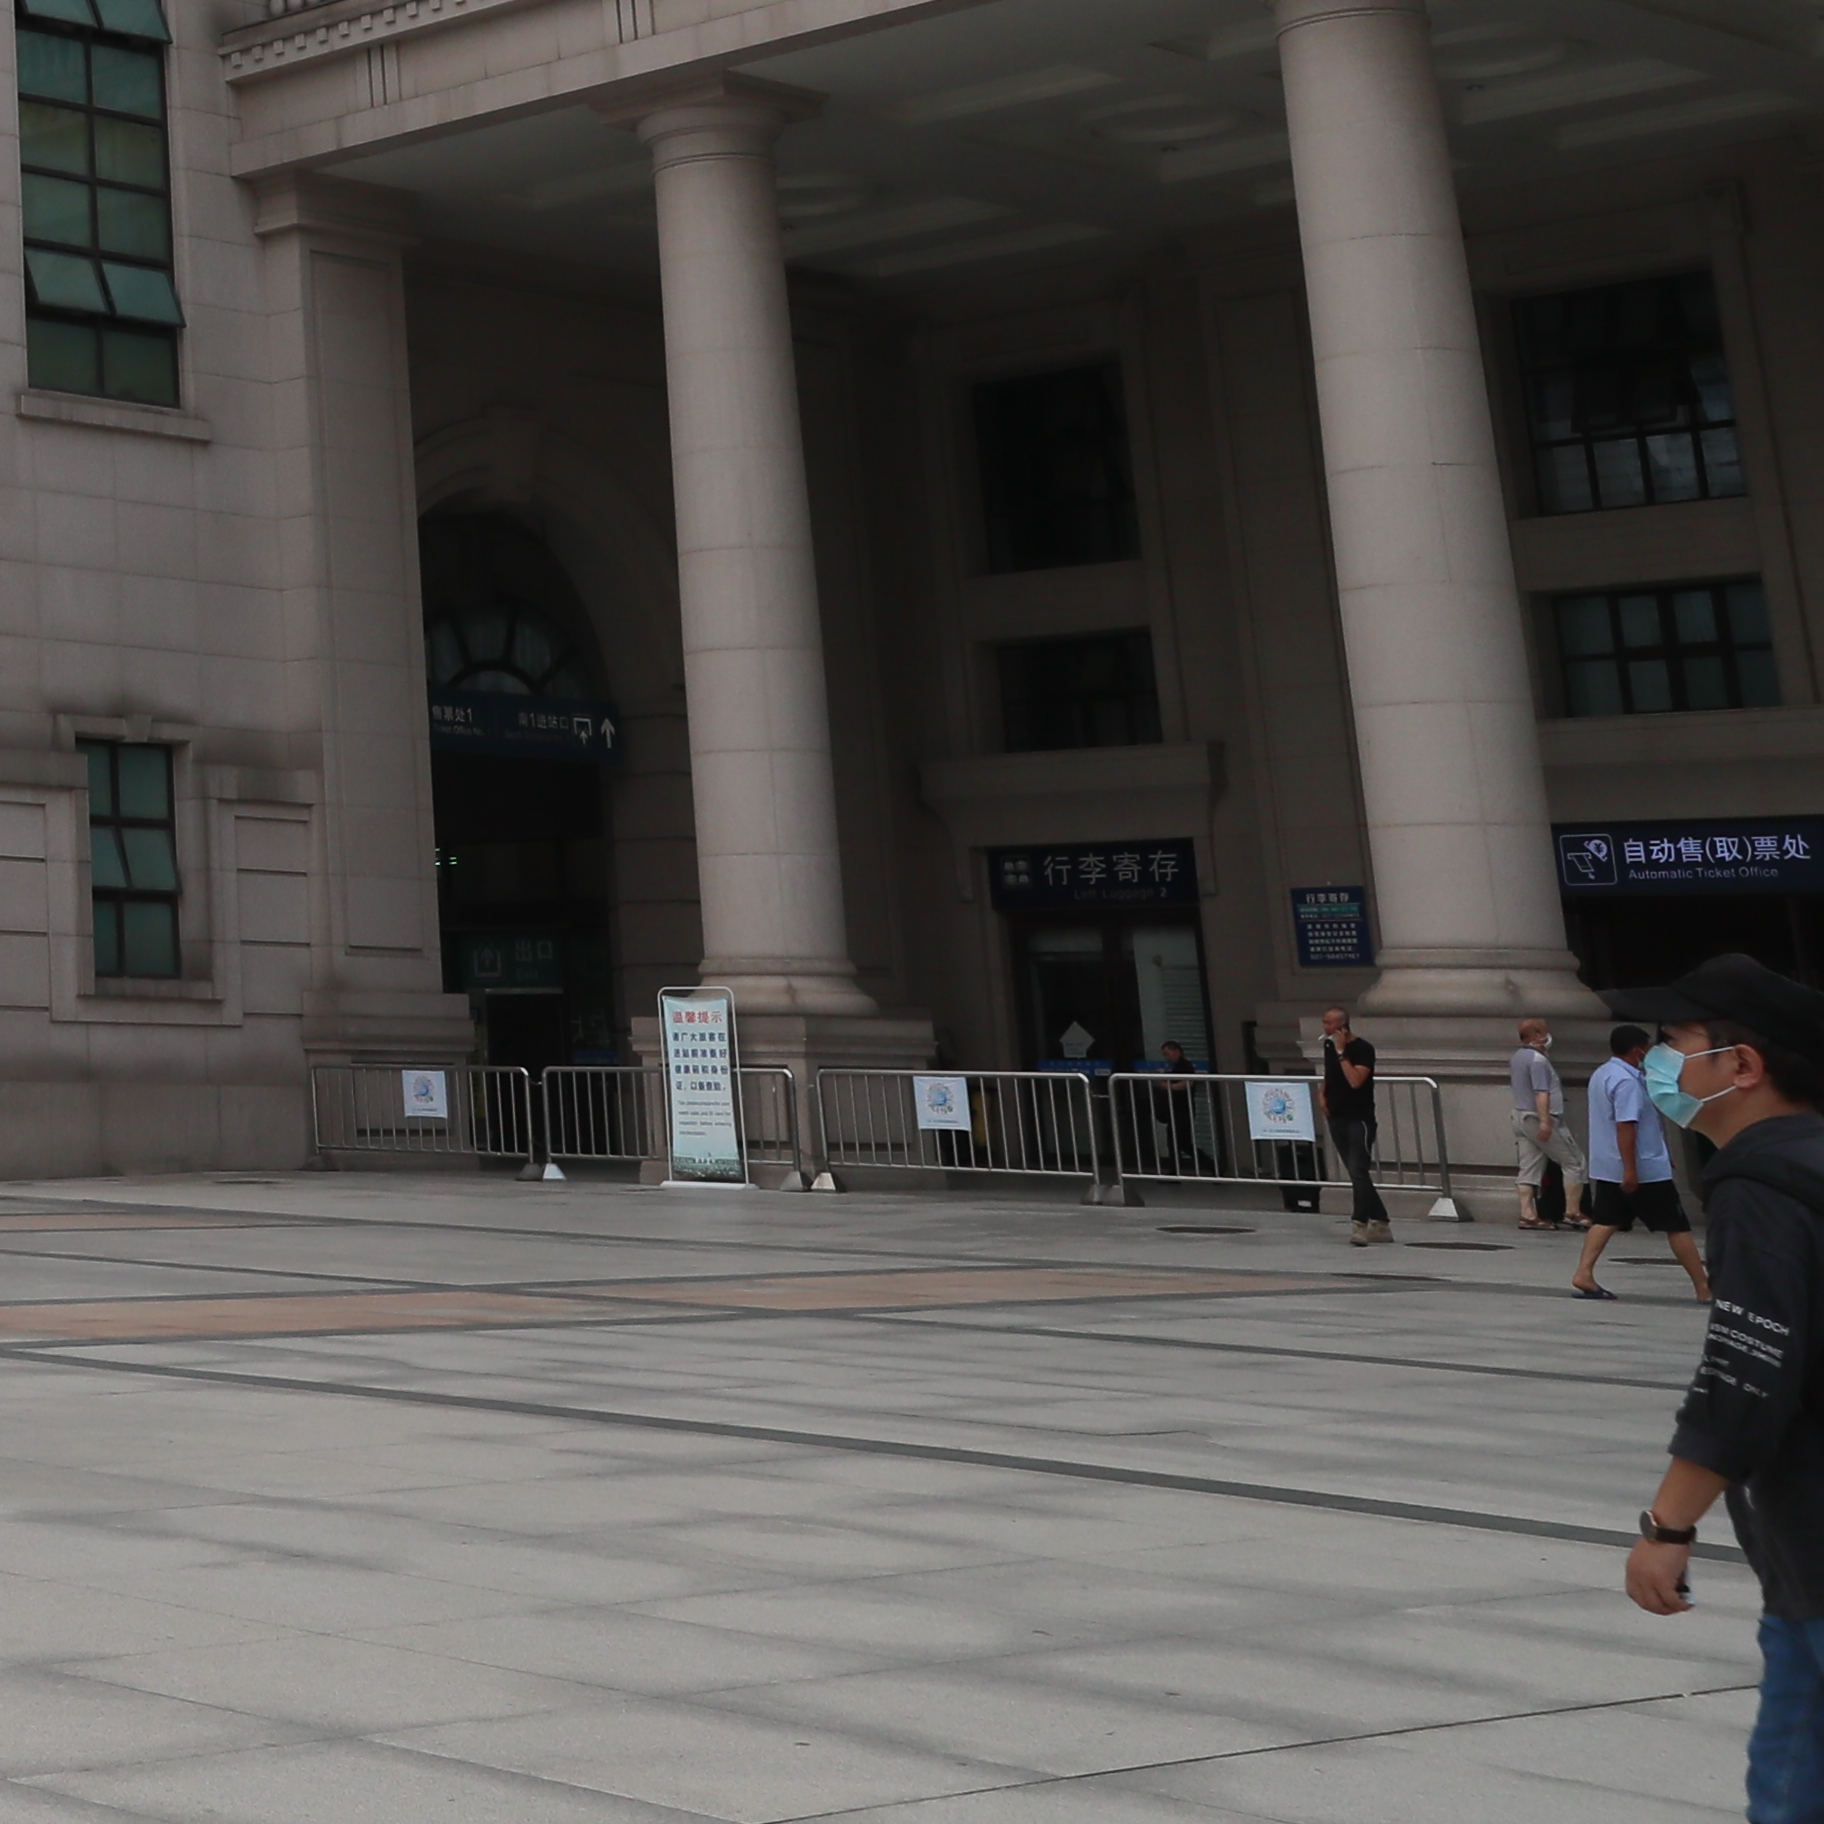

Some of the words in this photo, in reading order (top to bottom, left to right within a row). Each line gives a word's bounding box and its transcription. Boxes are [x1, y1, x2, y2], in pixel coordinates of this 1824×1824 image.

[1043, 850, 1180, 887] 行李寄存
[1628, 868, 1693, 881] Automatic
[1696, 866, 1736, 879] Ticket
[1740, 865, 1779, 878] Office
[515, 938, 553, 963] 出口
[672, 1010, 724, 1024] 温馨提示
[1714, 1298, 1746, 1316] NEW
[1747, 1311, 1790, 1337] EPOCH
